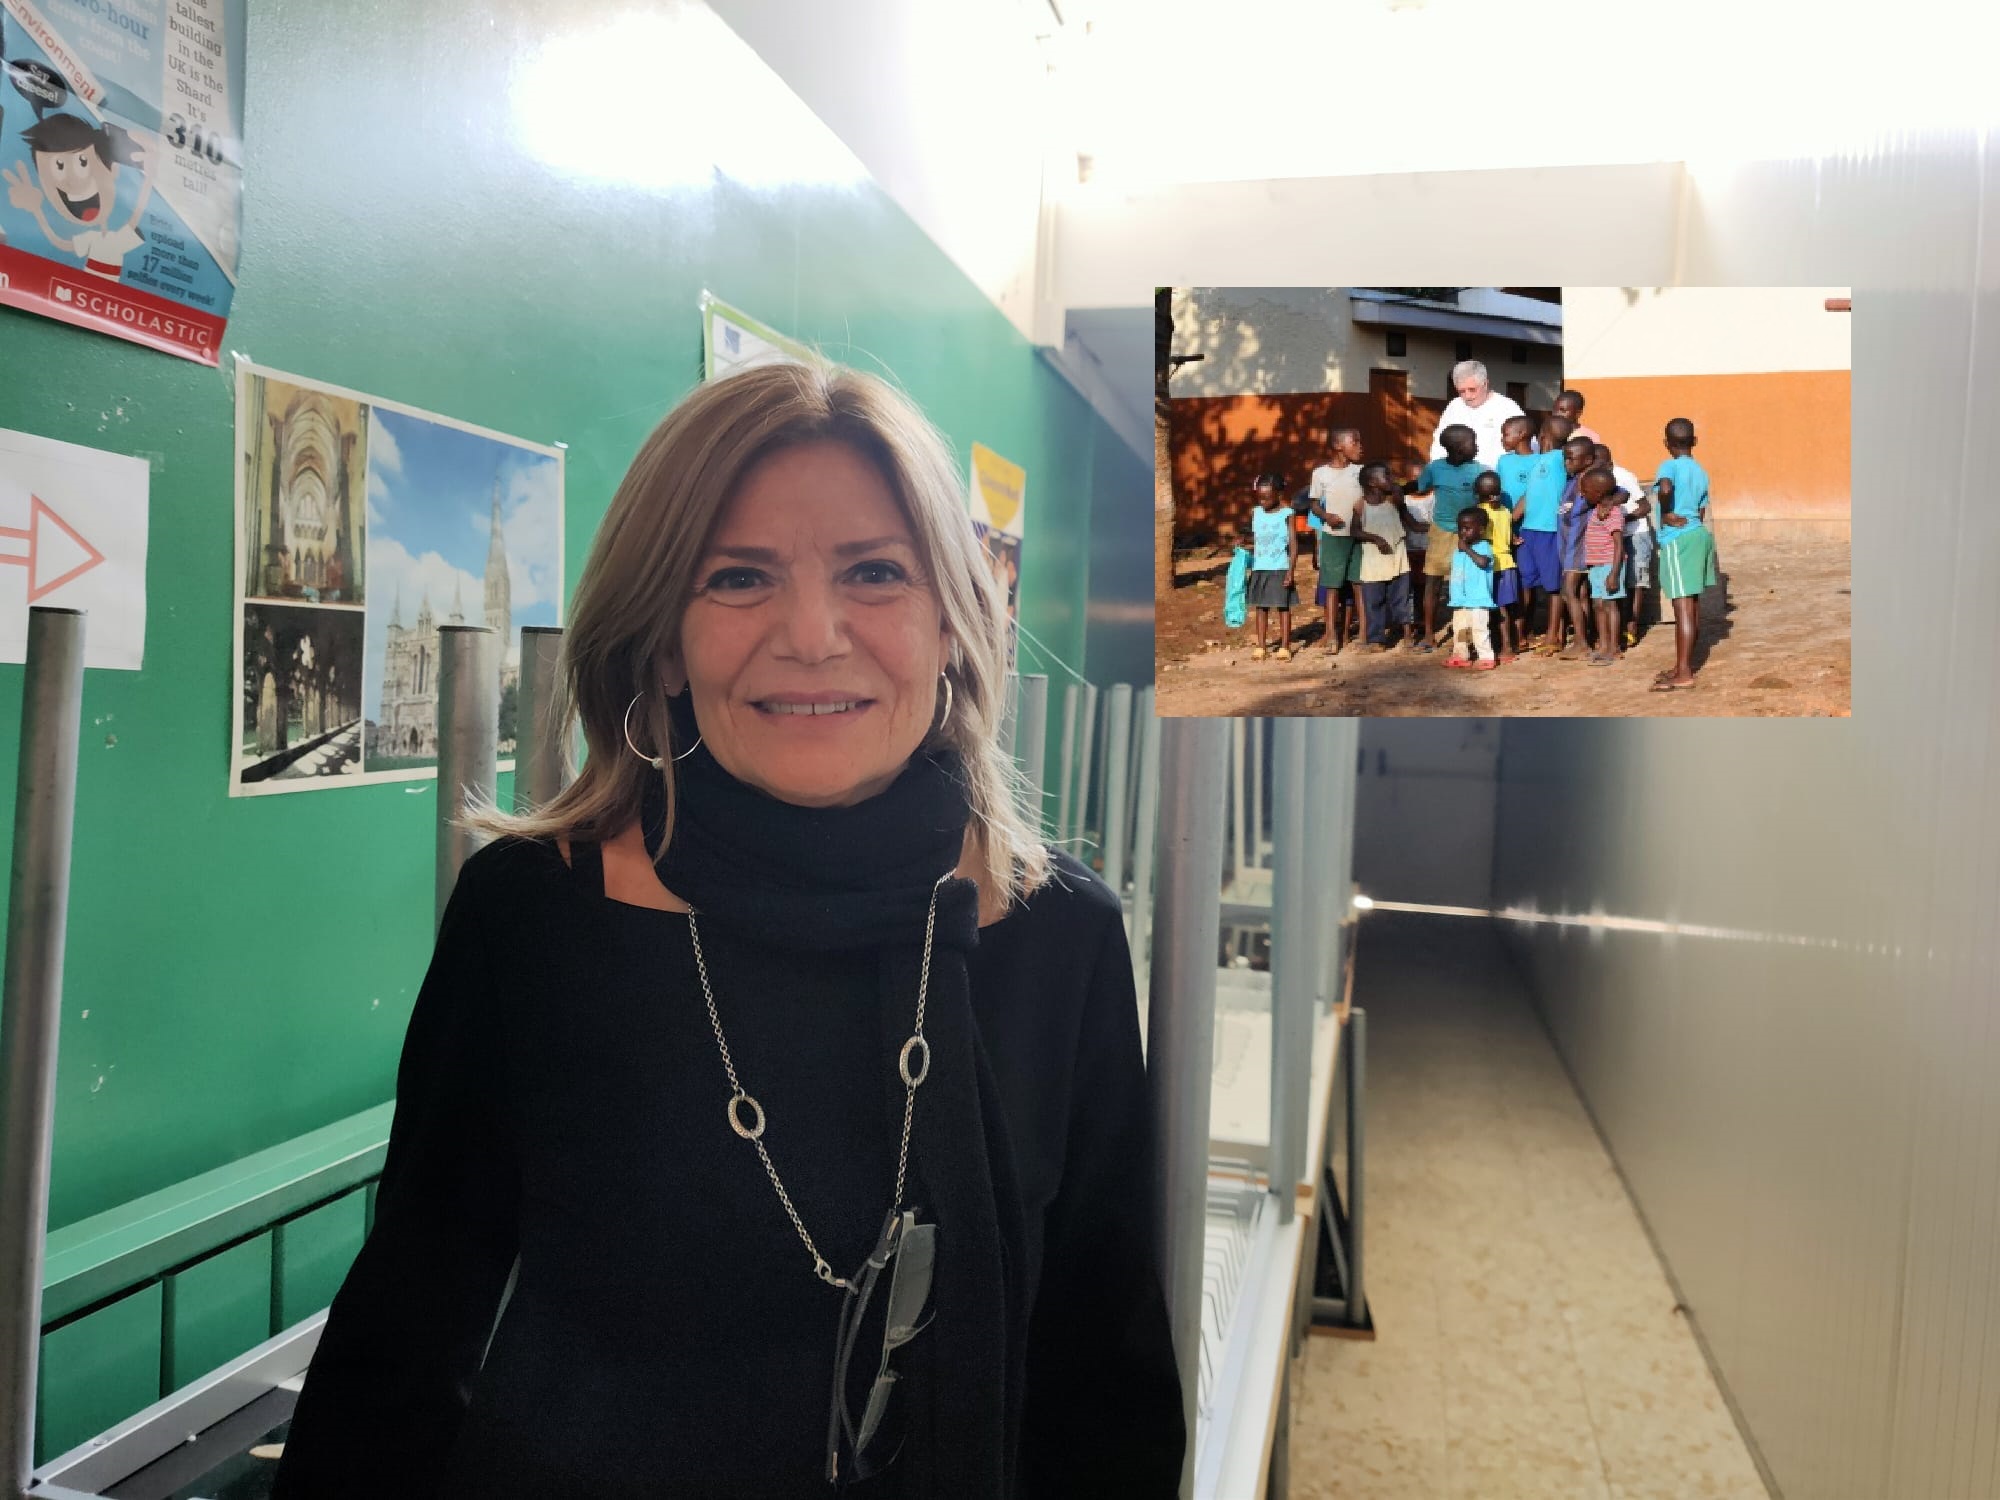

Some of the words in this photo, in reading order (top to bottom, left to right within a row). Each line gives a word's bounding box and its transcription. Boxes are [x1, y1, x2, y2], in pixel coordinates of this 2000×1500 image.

[74, 0, 150, 40] o-hour
[169, 15, 222, 57] building
[176, 2, 215, 32] tallest
[168, 53, 187, 75] UK
[190, 65, 201, 82] is
[203, 74, 224, 93] the
[178, 40, 190, 58] in
[193, 50, 214, 69] the
[166, 112, 223, 166] 310
[142, 254, 160, 273] 17
[76, 292, 209, 345] SCHOLASTIC
